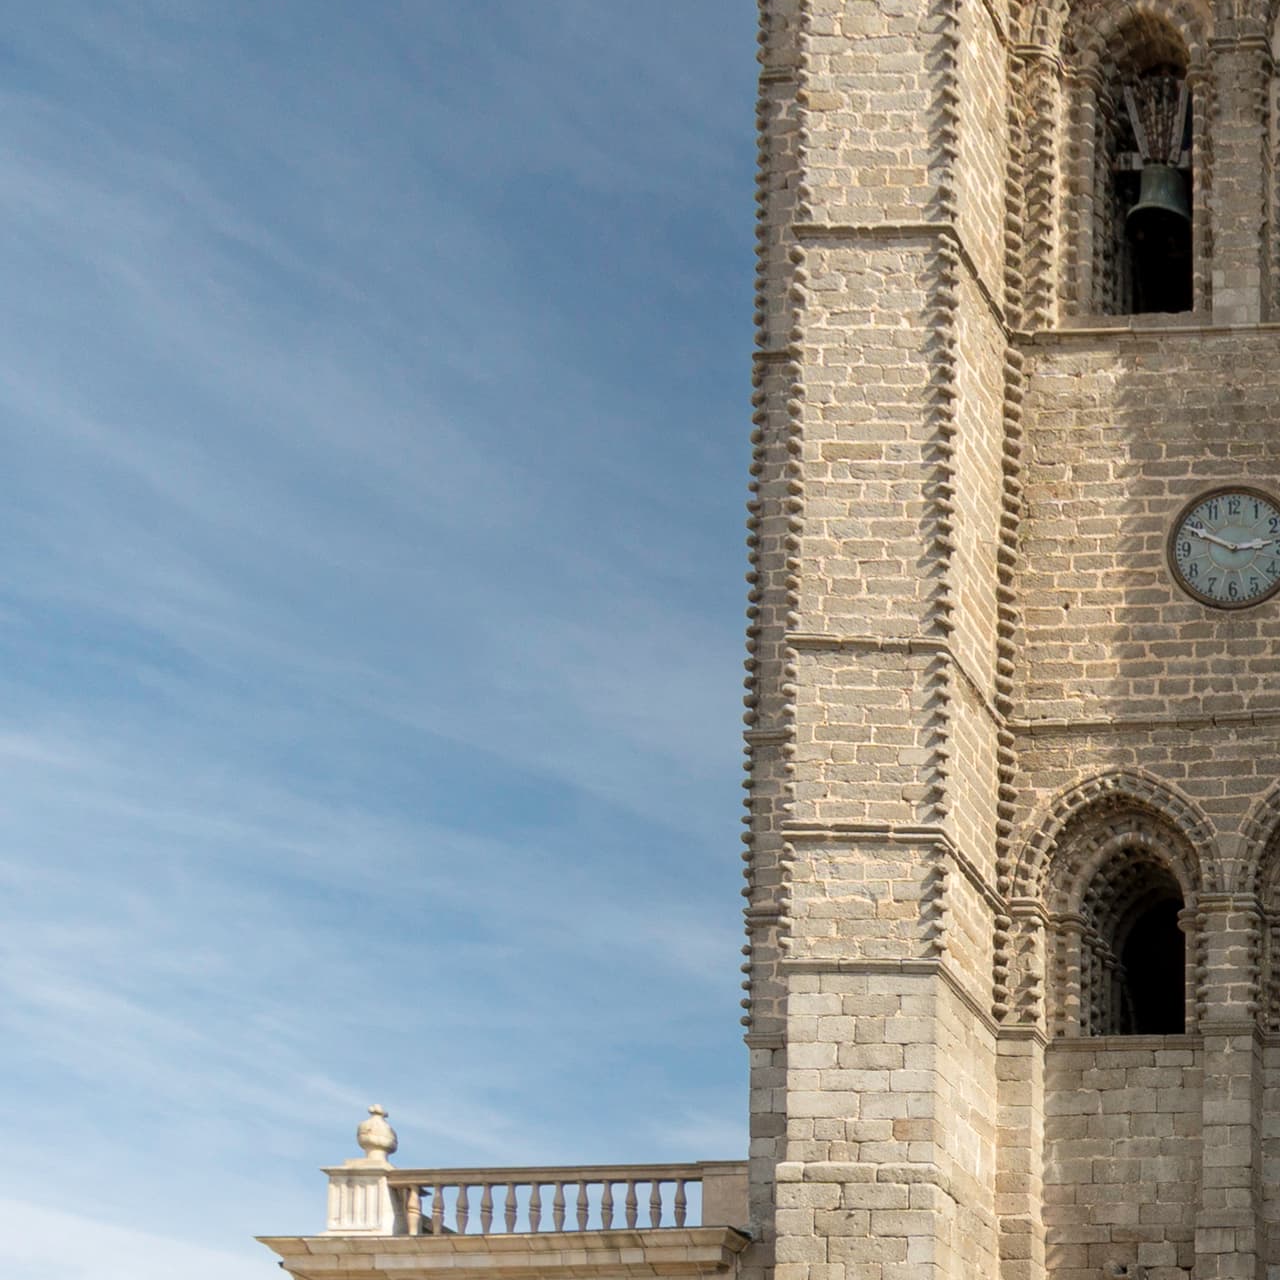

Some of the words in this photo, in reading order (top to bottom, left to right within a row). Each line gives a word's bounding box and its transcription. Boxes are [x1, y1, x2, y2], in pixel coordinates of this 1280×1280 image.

[1208, 504, 1218, 520] 11
[1228, 500, 1240, 515] 12
[1253, 503, 1259, 519] 1
[1269, 518, 1278, 533] 2
[1182, 542, 1191, 558] 9
[1189, 564, 1198, 577] 8
[1266, 560, 1277, 575] 4
[1208, 578, 1217, 592] 7
[1229, 582, 1237, 597] 6
[1250, 578, 1258, 593] 5
